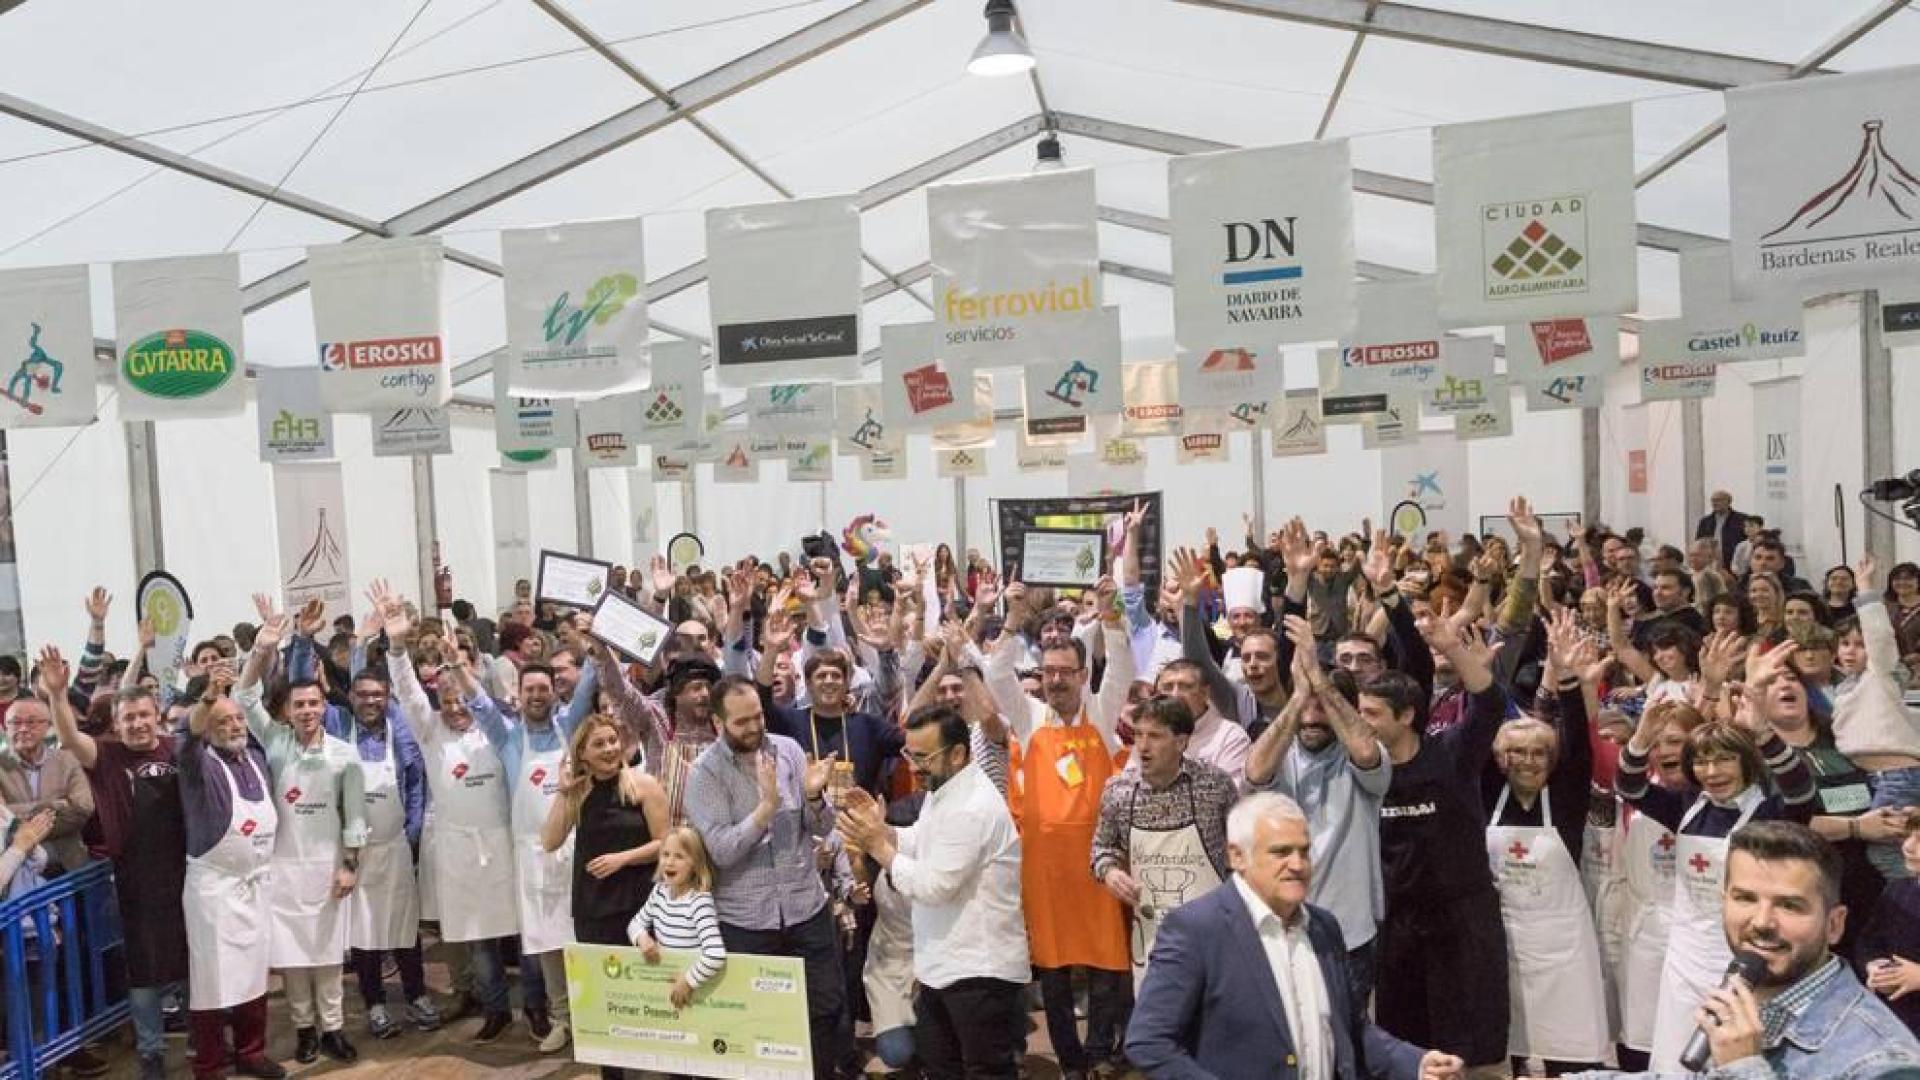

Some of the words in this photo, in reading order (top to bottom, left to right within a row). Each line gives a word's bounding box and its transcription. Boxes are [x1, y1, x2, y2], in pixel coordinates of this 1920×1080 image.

[1486, 200, 1582, 220] CIUDAD
[1222, 216, 1298, 263] DN
[1761, 247, 1856, 271] Bardenas
[1489, 278, 1585, 296] AGROALIMENTARIA
[945, 276, 1094, 321] ferrovial
[1226, 291, 1278, 307] DIARIO
[1281, 288, 1302, 301] DE
[1226, 304, 1303, 324] NAVARRA
[946, 326, 1016, 344] servicios
[1688, 334, 1740, 351] Castel
[355, 342, 435, 364] EROSKI
[1369, 343, 1434, 362] EROSKI
[381, 368, 434, 397] contigo
[1767, 434, 1787, 460] DN
